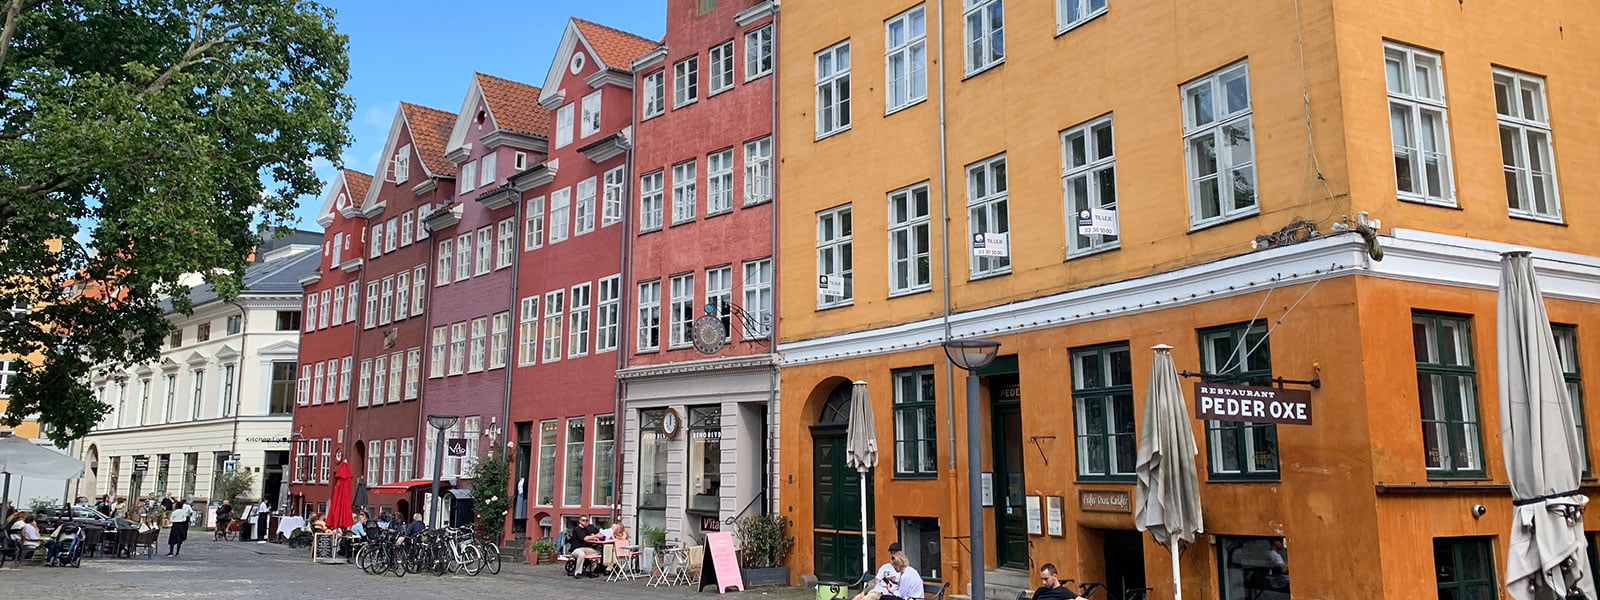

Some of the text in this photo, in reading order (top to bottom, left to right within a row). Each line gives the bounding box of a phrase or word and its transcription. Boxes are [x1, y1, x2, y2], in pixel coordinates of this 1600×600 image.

[1200, 386, 1275, 398] RESTAURANT
[1201, 396, 1307, 419] PEDER OXE
